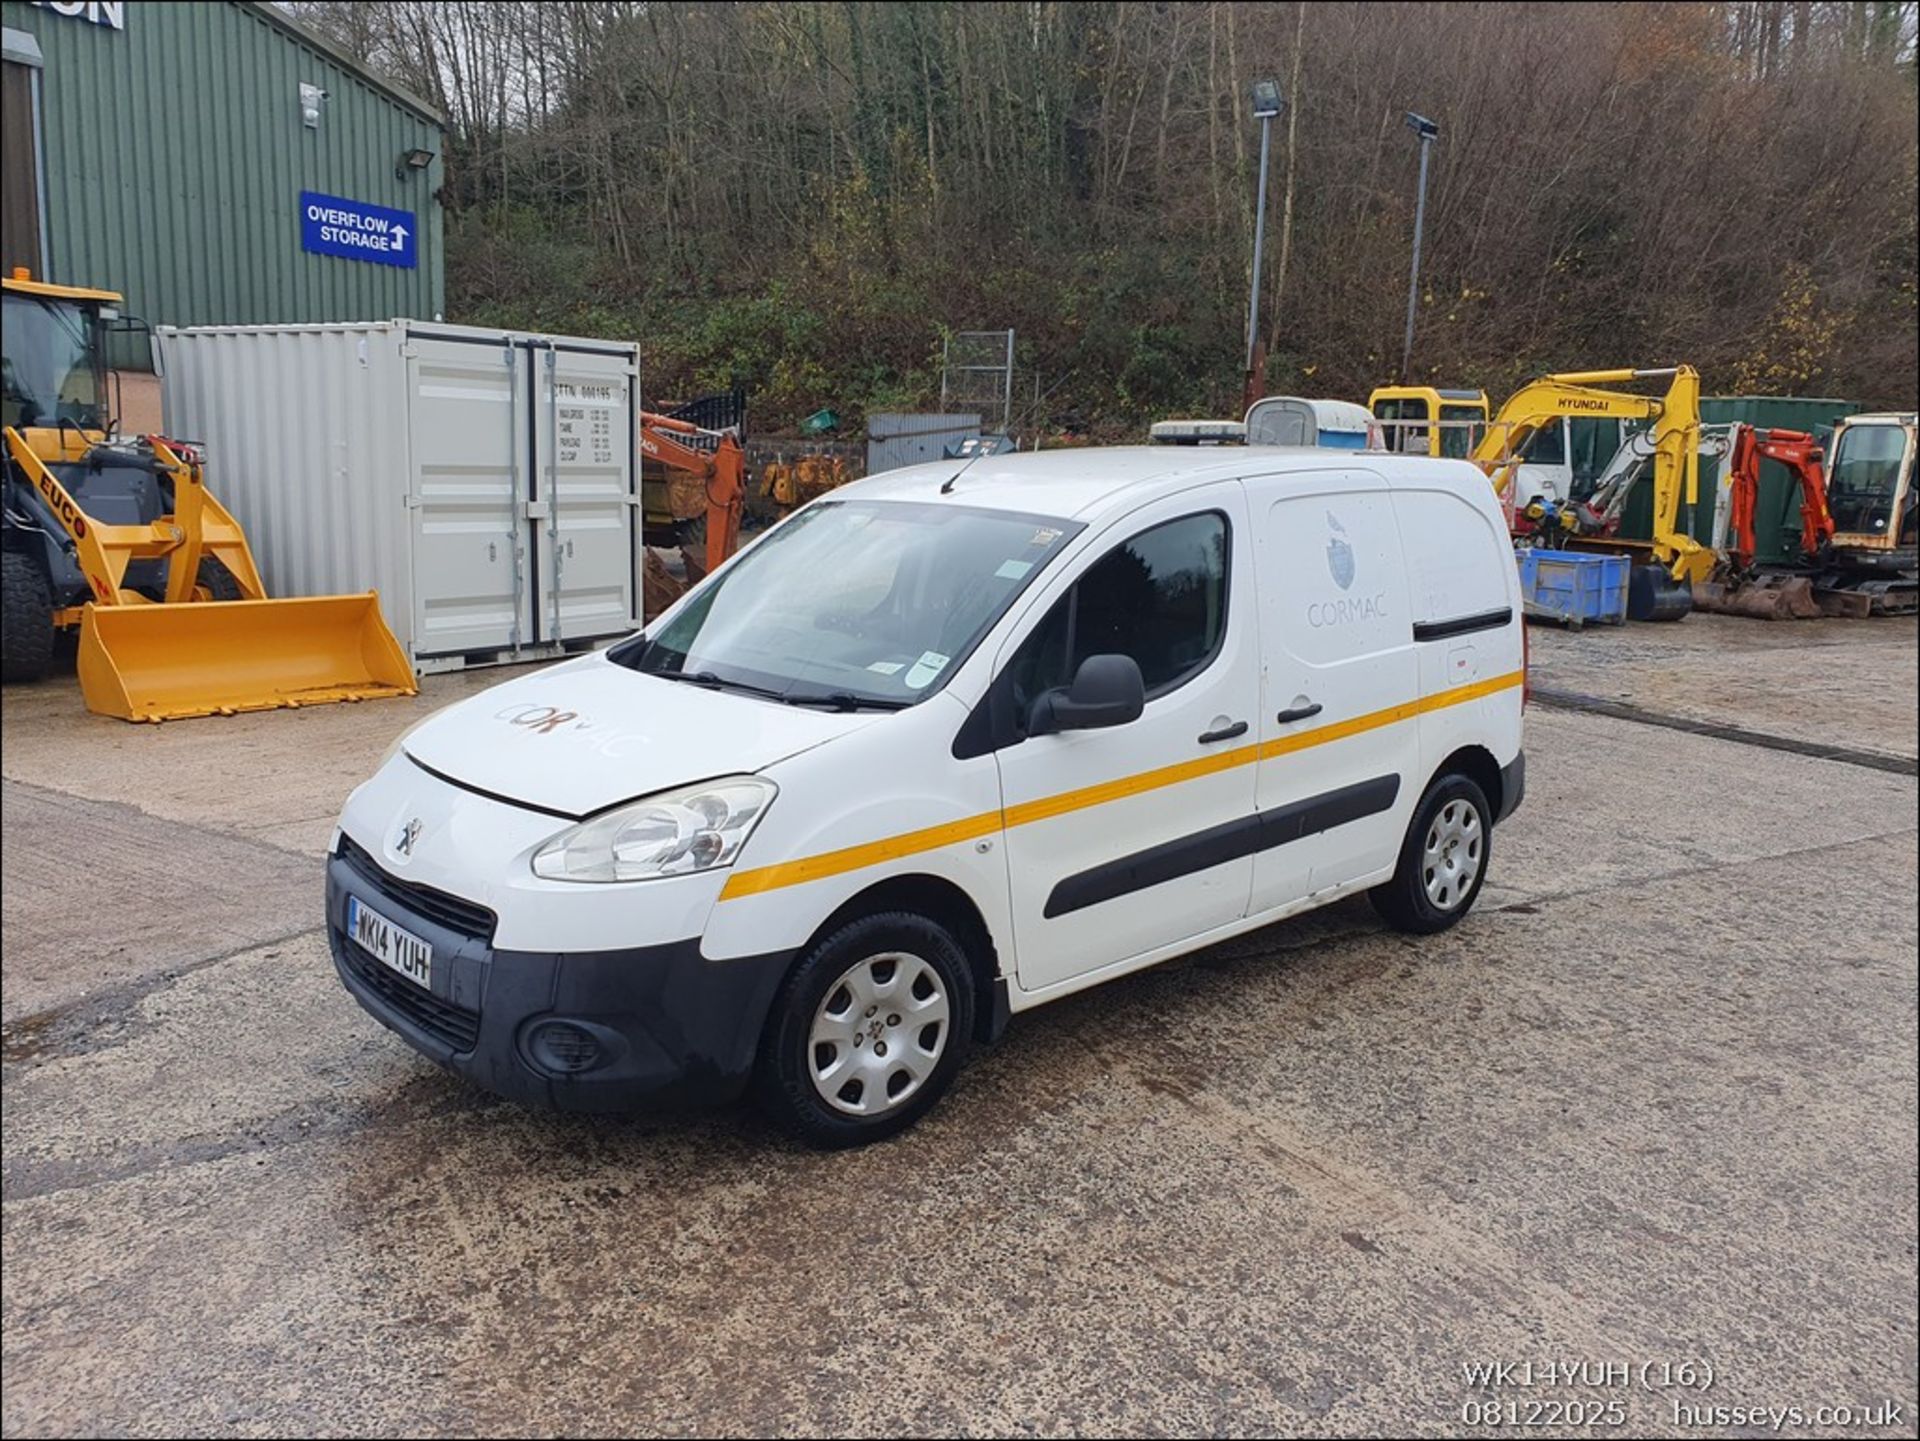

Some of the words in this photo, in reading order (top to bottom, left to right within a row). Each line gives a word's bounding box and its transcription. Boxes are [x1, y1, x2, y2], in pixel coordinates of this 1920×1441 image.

[307, 205, 389, 233] OVERFLOW
[320, 226, 390, 252] STORAGE
[1558, 398, 1609, 411] HYUNDAI
[40, 472, 86, 539] EUCO
[1307, 590, 1388, 628] CORMAC
[358, 907, 388, 957] WK14
[394, 931, 426, 980] YUH
